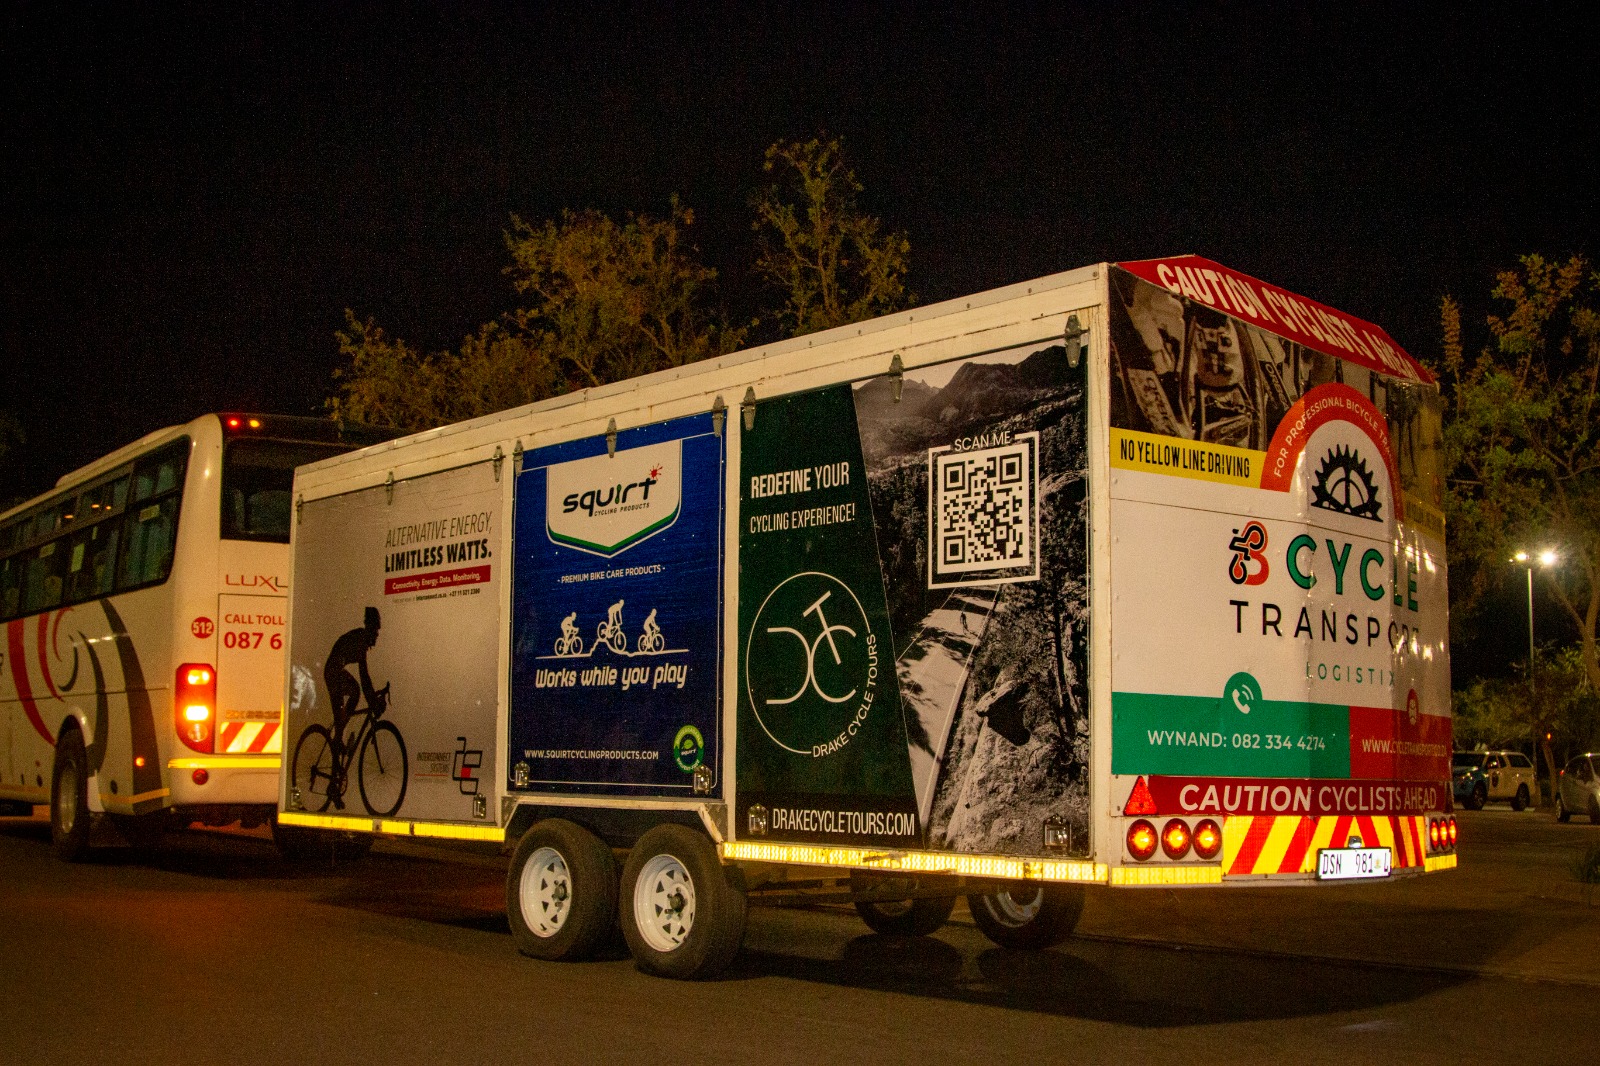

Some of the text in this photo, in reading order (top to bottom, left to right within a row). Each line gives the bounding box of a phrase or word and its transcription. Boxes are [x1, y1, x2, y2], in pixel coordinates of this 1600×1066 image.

[1156, 263, 1276, 325] CAUTION
[954, 430, 1011, 451] SCAN ME
[1273, 448, 1289, 478] FOR
[1285, 396, 1345, 446] PROFESSIONAL
[1346, 398, 1378, 432] BICYCLE
[1120, 438, 1250, 478] NO YELLOW LINE DRIVING
[751, 461, 850, 499] REDEFINE YOUR
[563, 477, 657, 517] squirt
[594, 502, 650, 517] CYCLING PRODUCTS
[385, 511, 492, 548] ALTERNATIVE ENERGY,
[750, 502, 856, 534] CYCLING EXPERIENCE!
[385, 538, 492, 573] LIMITLESS WATTS.
[561, 564, 661, 584] PREMIUM BIKE CARE PRODUCTS
[192, 621, 213, 634] 512
[225, 613, 254, 625] CALL
[224, 631, 282, 650] 087 6
[535, 663, 688, 690] Works while you play
[812, 632, 878, 758] DRAKE CYCLE TOURS
[1147, 730, 1326, 750] WYNAND: 082 334 4274
[524, 749, 659, 760] WWW.SQUIRTCYCLINGPRODUCTS.COM
[1179, 784, 1437, 811] CAUTION CYCLISTS AHEAD
[773, 808, 915, 836] DRAKECYCLETOURS.COM
[1322, 854, 1342, 874] DSN
[1355, 852, 1373, 873] 981
